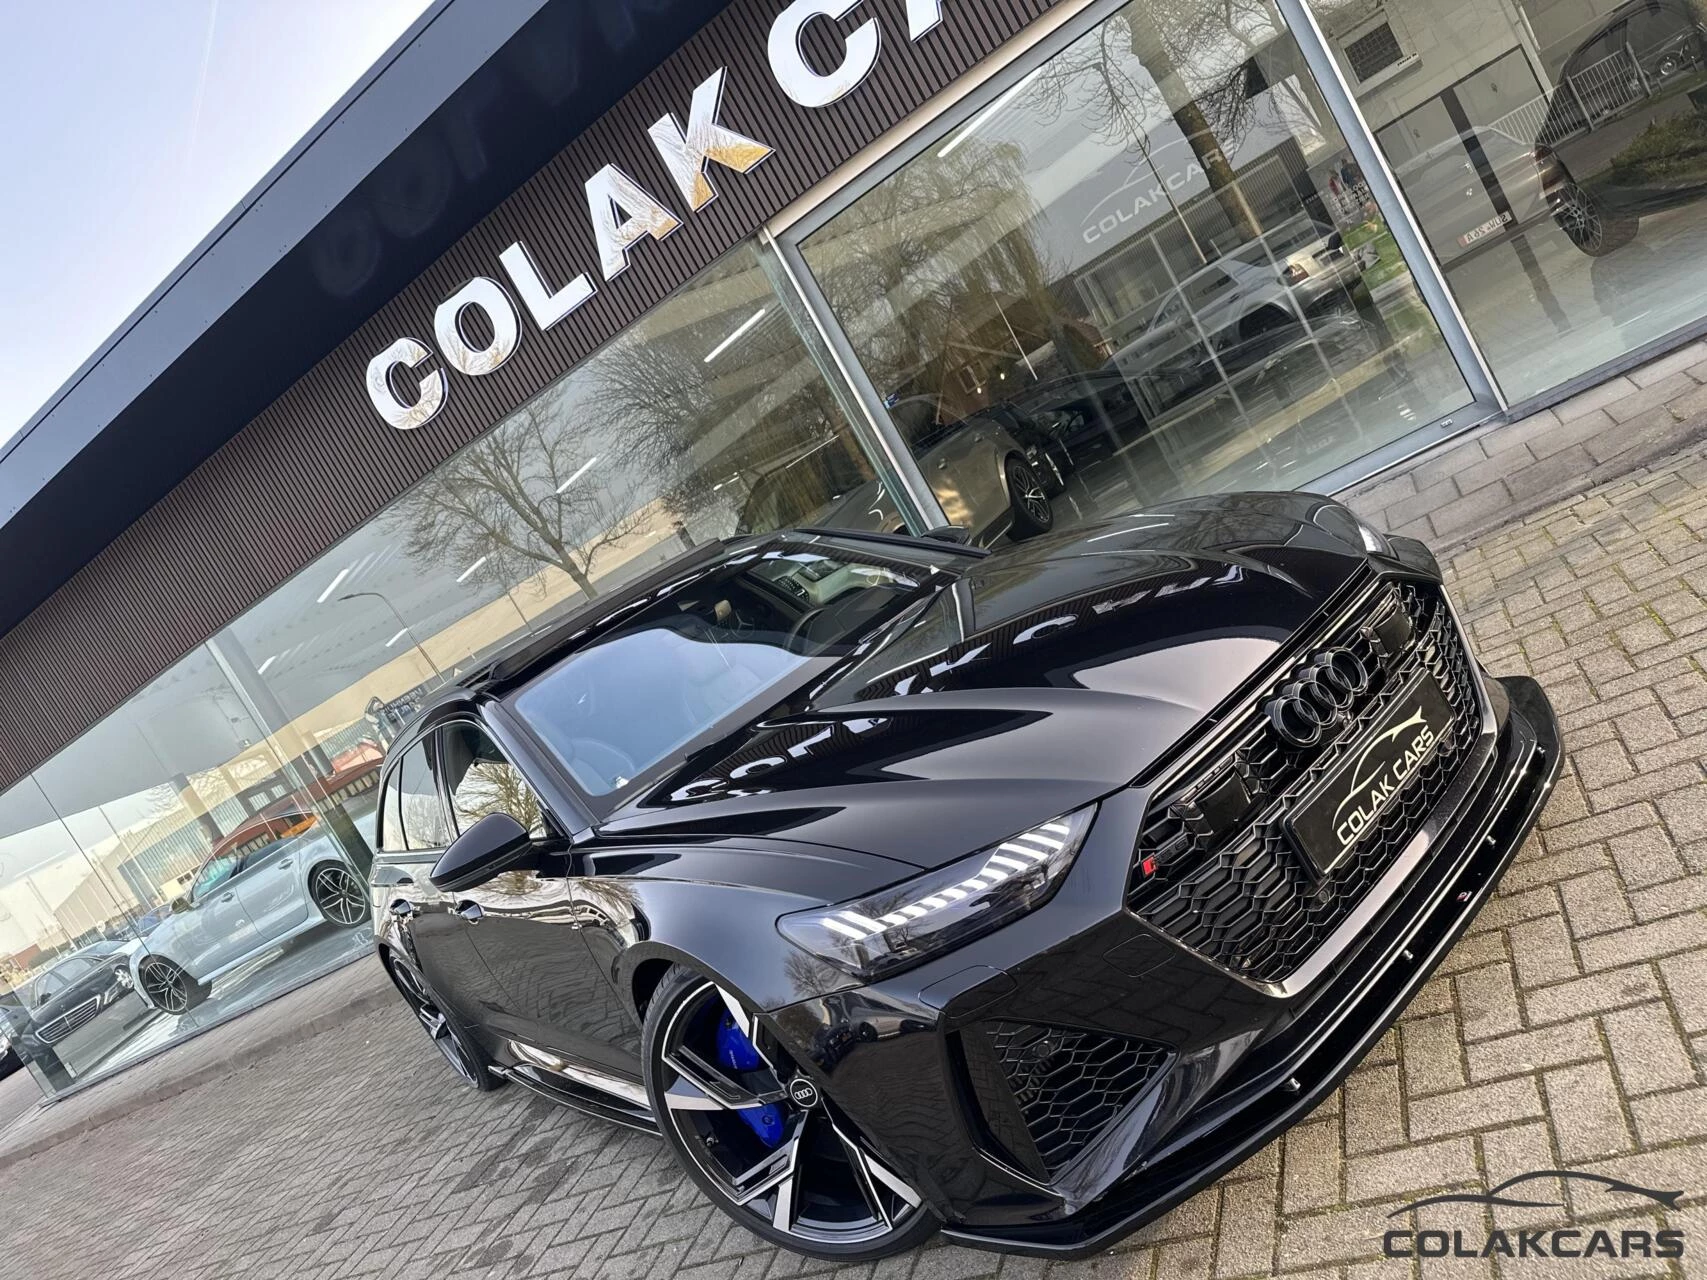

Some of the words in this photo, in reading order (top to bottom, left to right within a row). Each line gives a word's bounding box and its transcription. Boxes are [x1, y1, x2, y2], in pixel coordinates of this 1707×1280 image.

[365, 66, 776, 430] COLAK
[767, 0, 944, 109] C
[1336, 773, 1395, 846] COLAK
[1393, 724, 1434, 781] CARS
